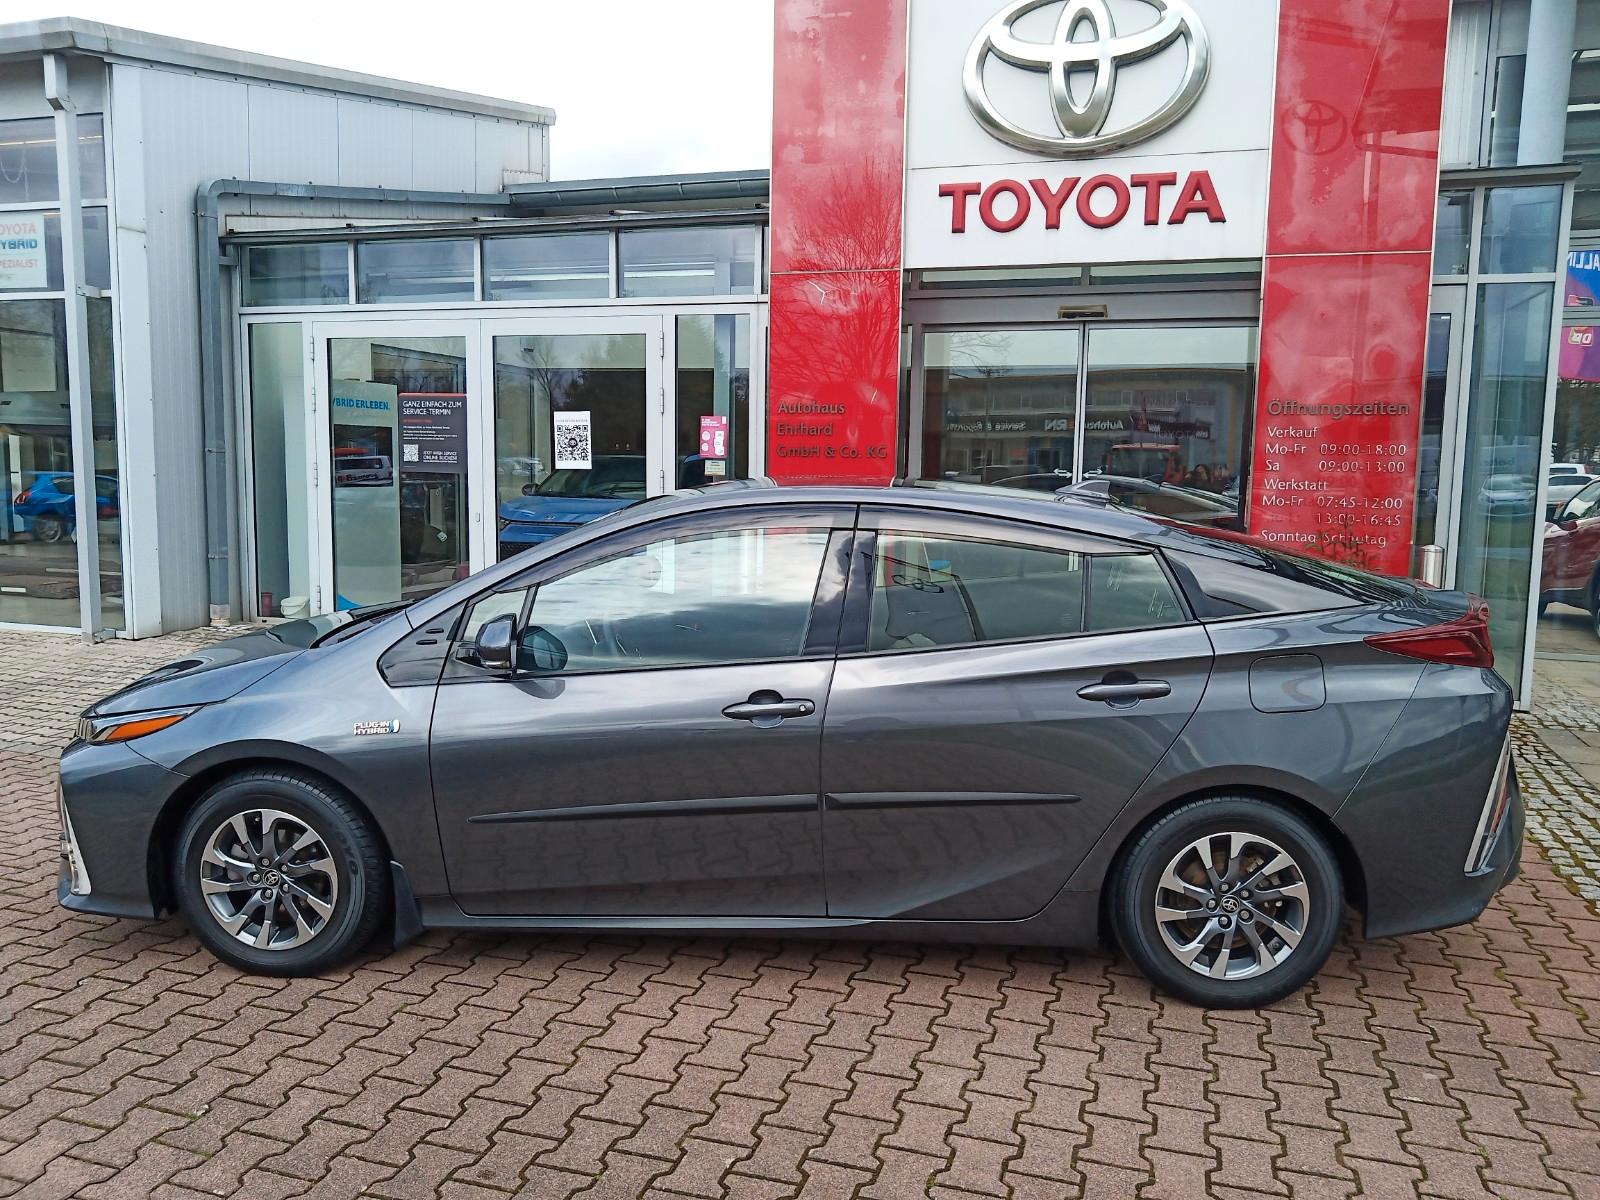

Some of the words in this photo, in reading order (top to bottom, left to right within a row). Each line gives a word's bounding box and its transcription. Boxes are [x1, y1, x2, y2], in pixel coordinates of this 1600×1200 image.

[938, 170, 1227, 234] TOYOTA
[778, 400, 845, 414] Autohaus
[1267, 399, 1410, 419] Öffnungszeiten
[777, 422, 833, 436] Ehrhard
[1268, 427, 1318, 438] Verkauf
[777, 445, 820, 458] GmbH
[825, 446, 837, 458] &
[840, 445, 862, 458] Co.
[867, 446, 888, 459] KG
[1265, 444, 1307, 455] Mo-Fr
[1320, 444, 1406, 456] 09:00-18:00
[1265, 460, 1281, 471] Sa
[1319, 461, 1405, 473] 09:00-13:00
[1264, 478, 1329, 491] Werkstatt
[1262, 495, 1304, 507] Mo-Fr
[1317, 496, 1403, 509] 07:45-12:00
[1316, 513, 1401, 526] 13:00-16:45
[1261, 530, 1316, 543] Sonntag
[353, 720, 390, 728] PLUG-IN
